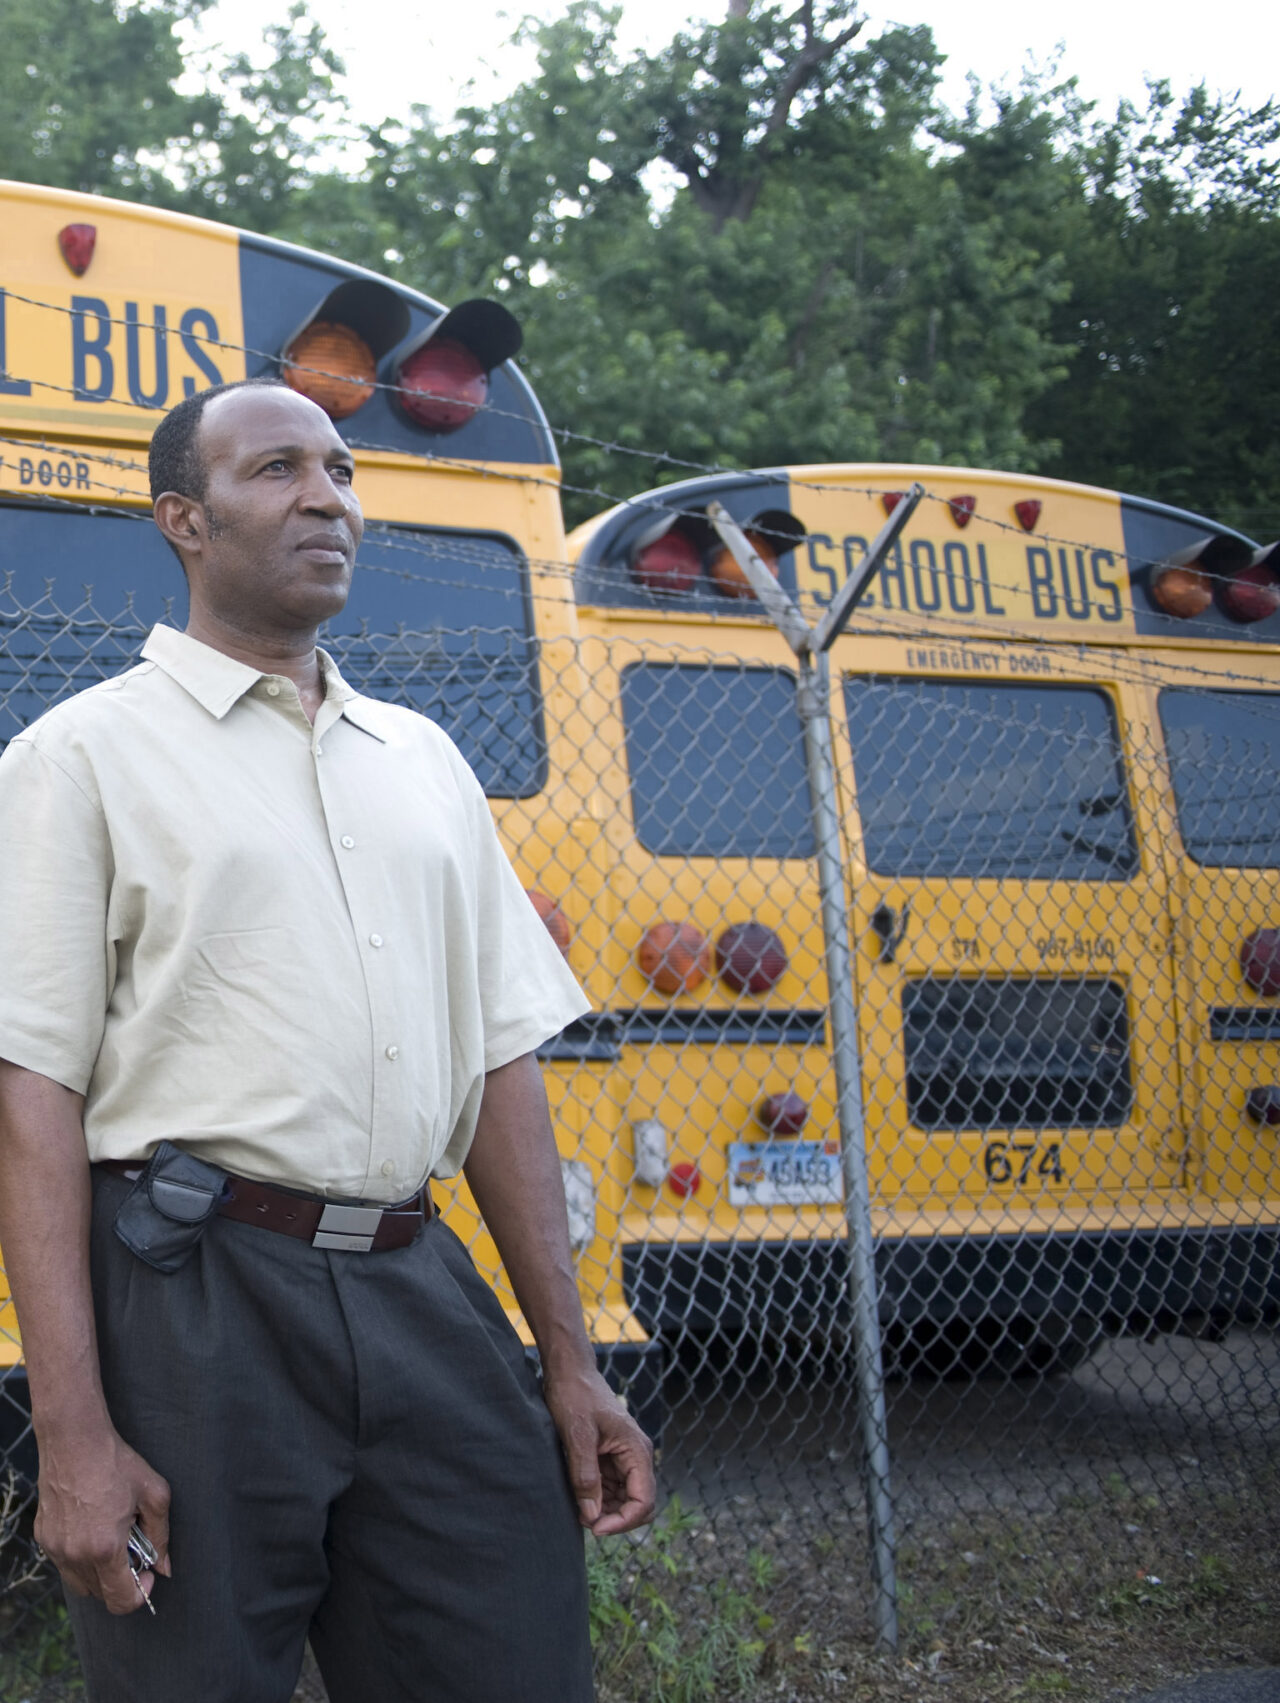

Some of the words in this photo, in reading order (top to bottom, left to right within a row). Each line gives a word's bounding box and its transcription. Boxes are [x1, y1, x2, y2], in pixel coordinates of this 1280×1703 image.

[70, 295, 226, 410] BUS
[19, 457, 91, 490] DOOR
[806, 533, 1006, 616] SCHOOL
[1025, 546, 1123, 622] BUS
[906, 648, 1000, 672] EMERGENCY
[1009, 654, 1051, 673] DOOR
[984, 1142, 1066, 1184] 674
